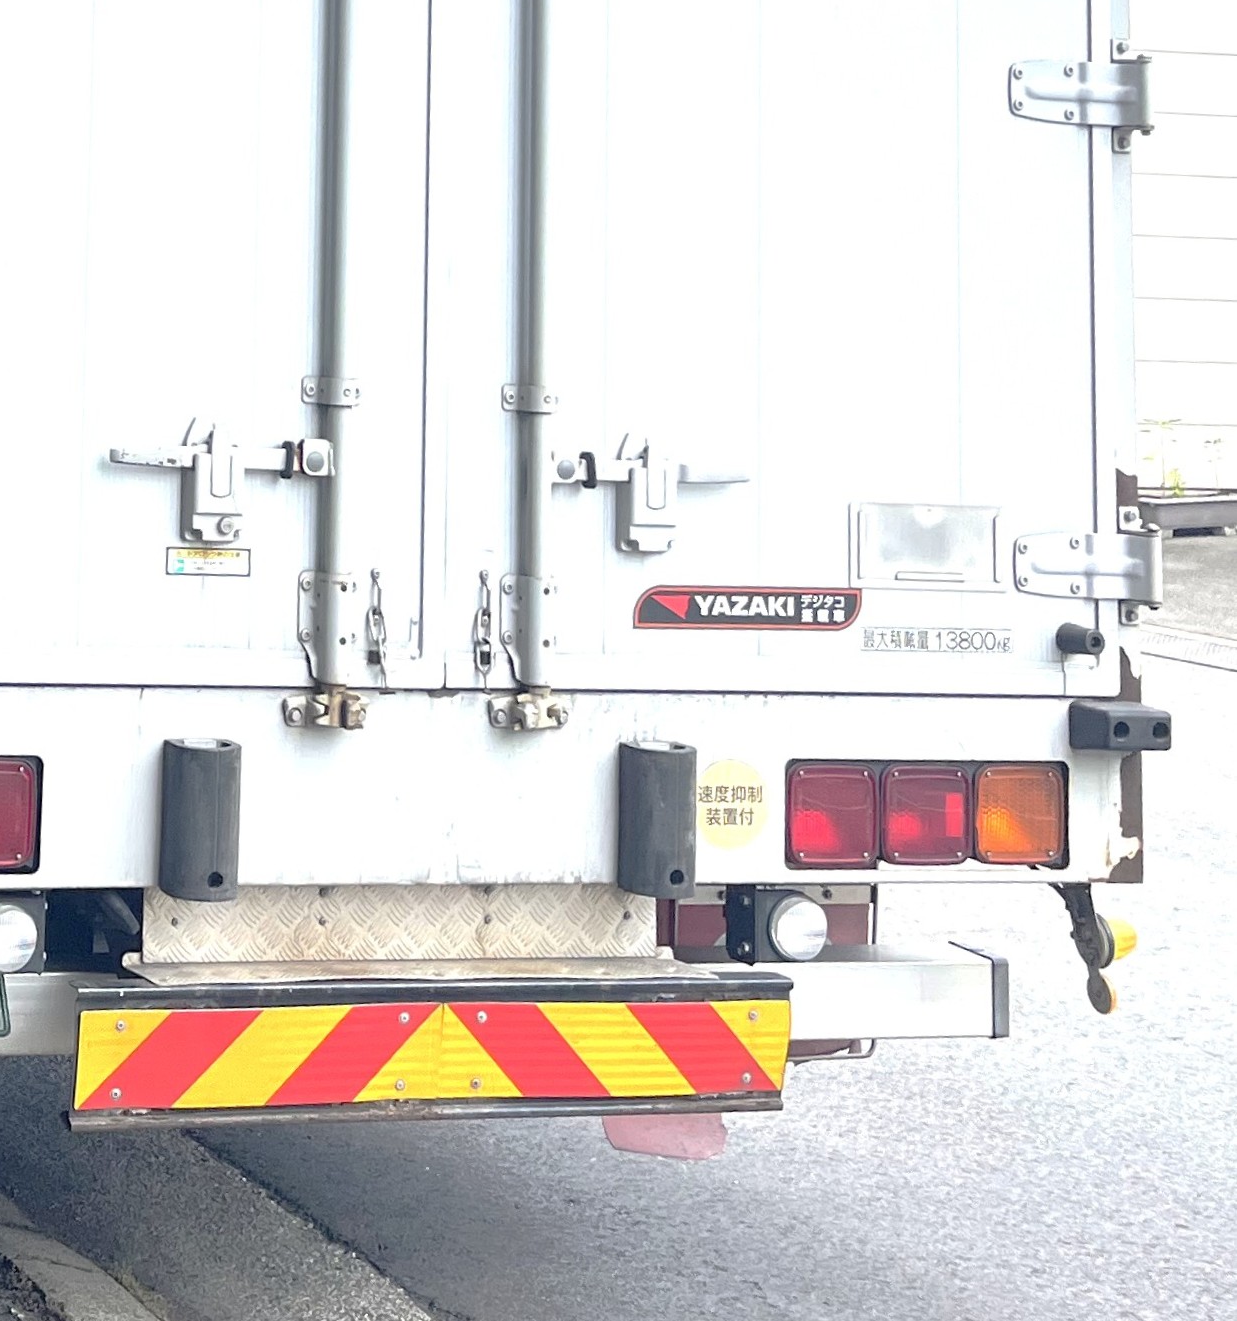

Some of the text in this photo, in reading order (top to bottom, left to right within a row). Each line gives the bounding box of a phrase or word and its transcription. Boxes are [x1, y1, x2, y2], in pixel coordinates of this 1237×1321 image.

[694, 594, 795, 617] YAZAKI
[698, 785, 763, 803] 速度抑制
[705, 807, 755, 826] 装置付
